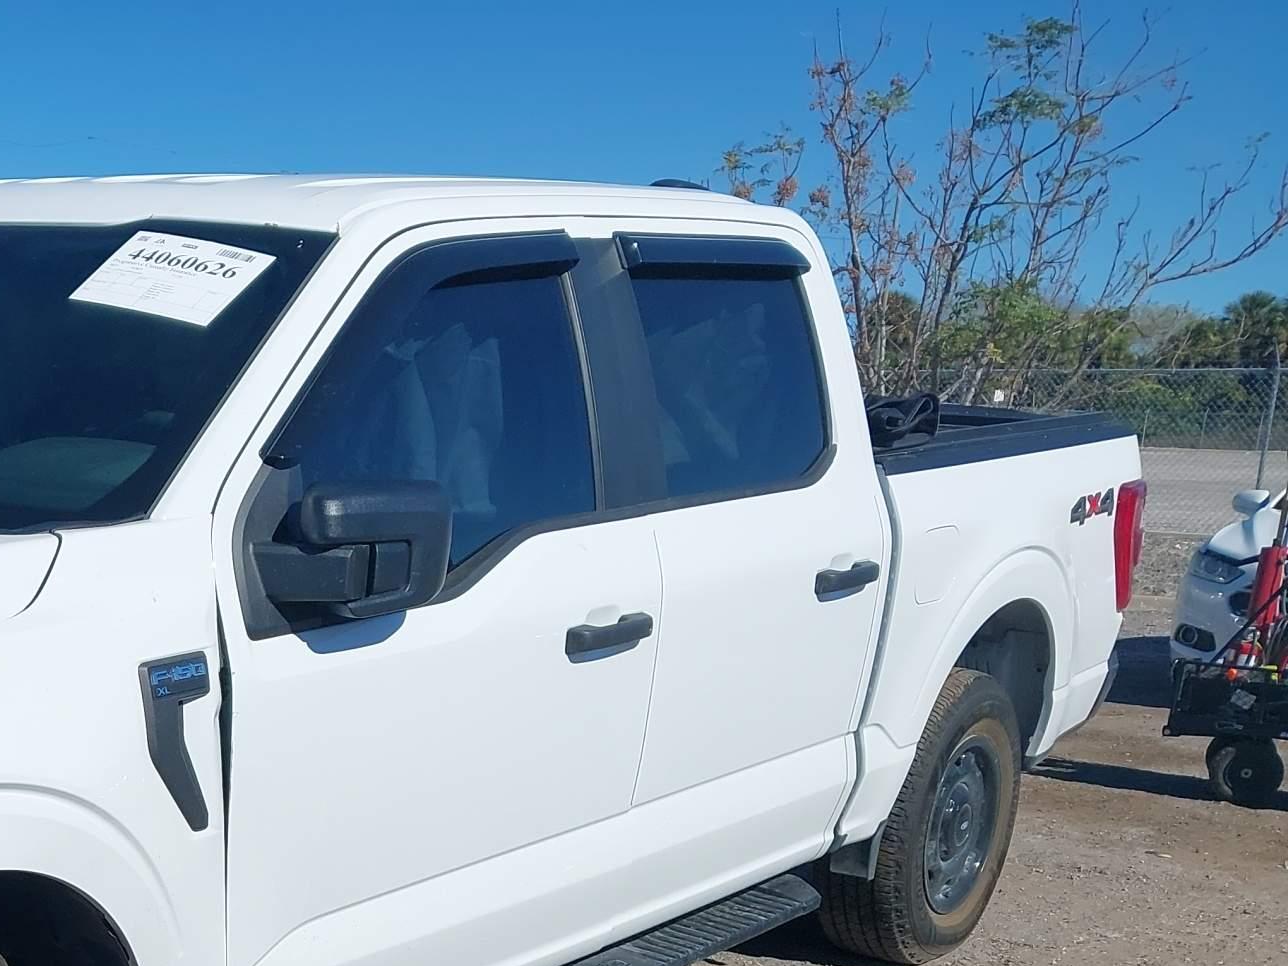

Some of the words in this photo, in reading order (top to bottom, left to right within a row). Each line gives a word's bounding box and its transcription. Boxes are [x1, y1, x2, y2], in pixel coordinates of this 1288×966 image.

[128, 248, 242, 279] 44060626
[151, 662, 206, 685] F-150
[156, 687, 171, 697] XL
